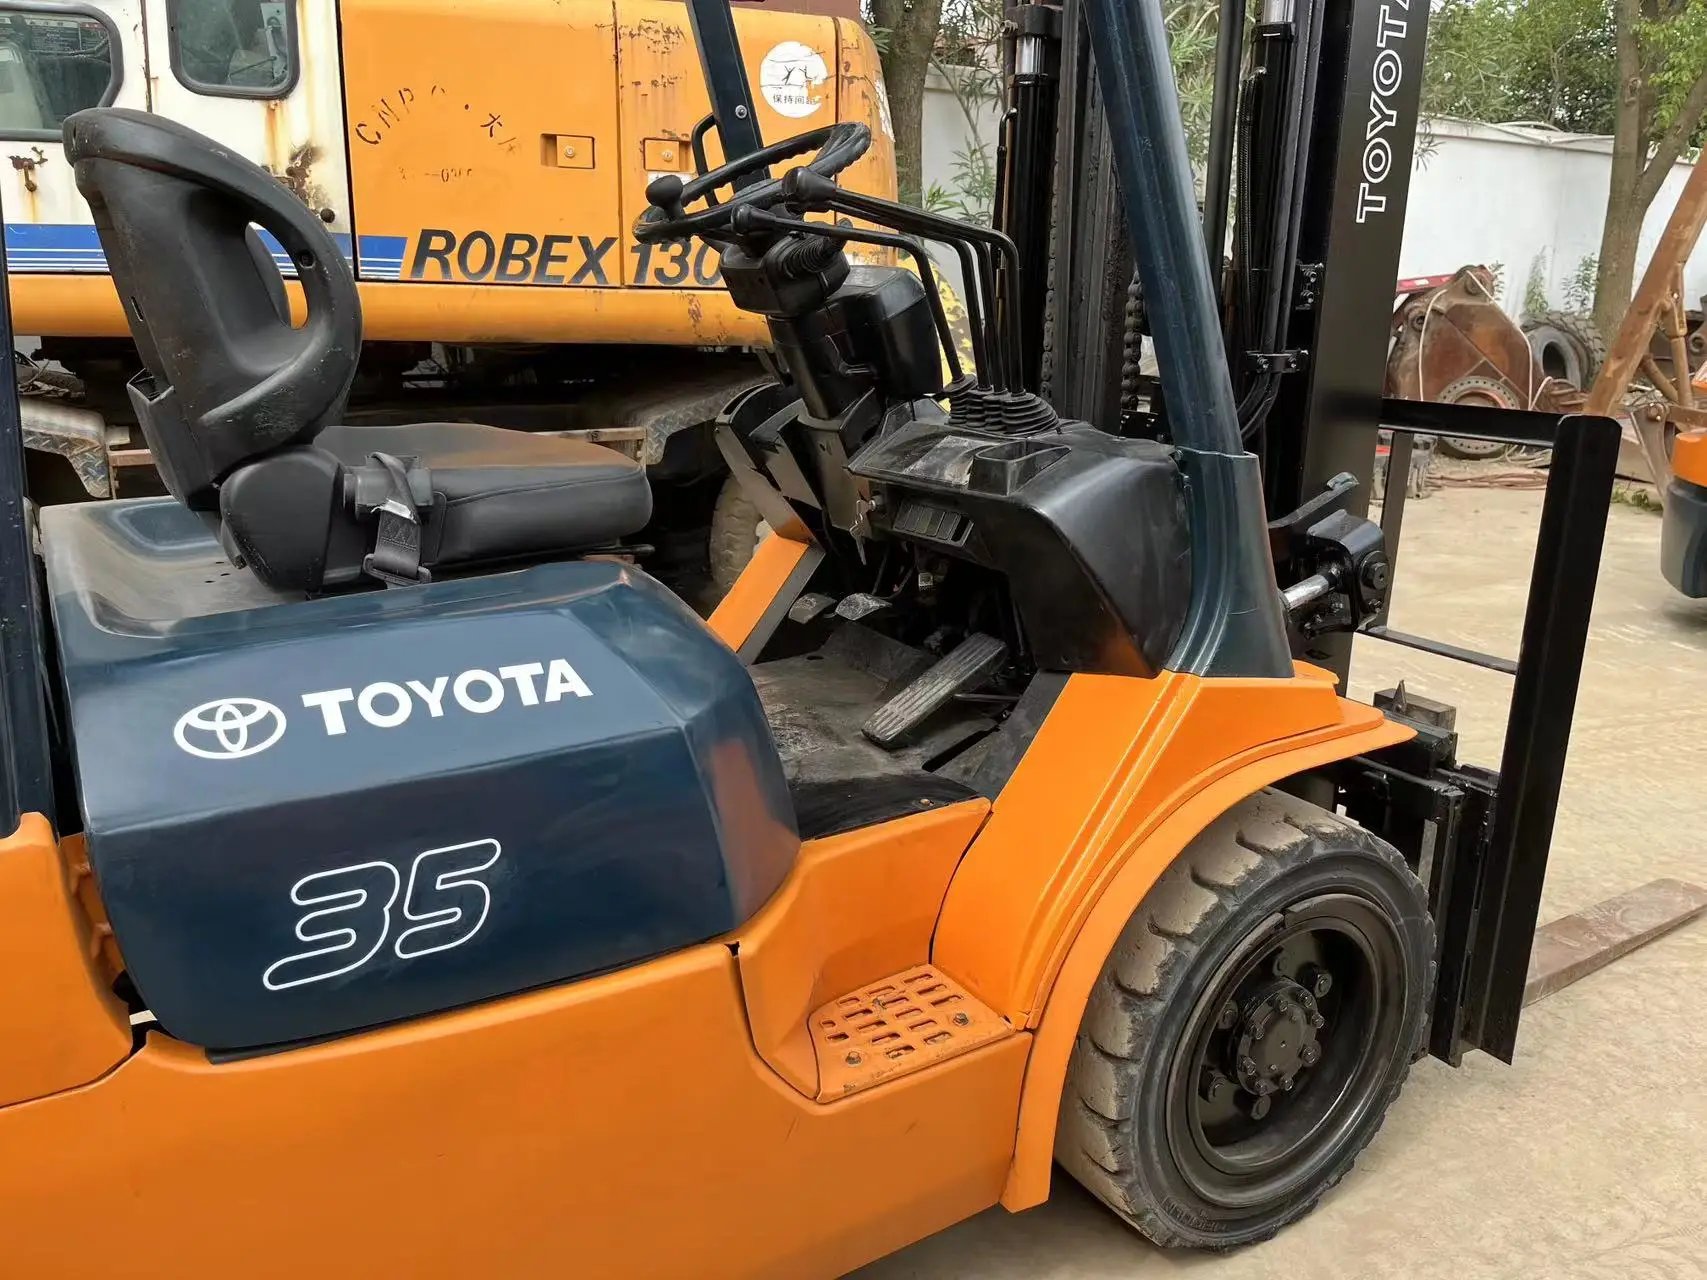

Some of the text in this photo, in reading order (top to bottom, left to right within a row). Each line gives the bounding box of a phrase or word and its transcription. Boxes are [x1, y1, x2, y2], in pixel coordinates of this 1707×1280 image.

[1356, 0, 1410, 223] TOYOT
[410, 228, 722, 285] ROBEX 130
[301, 658, 594, 736] TOYOTA
[263, 838, 502, 991] 35
